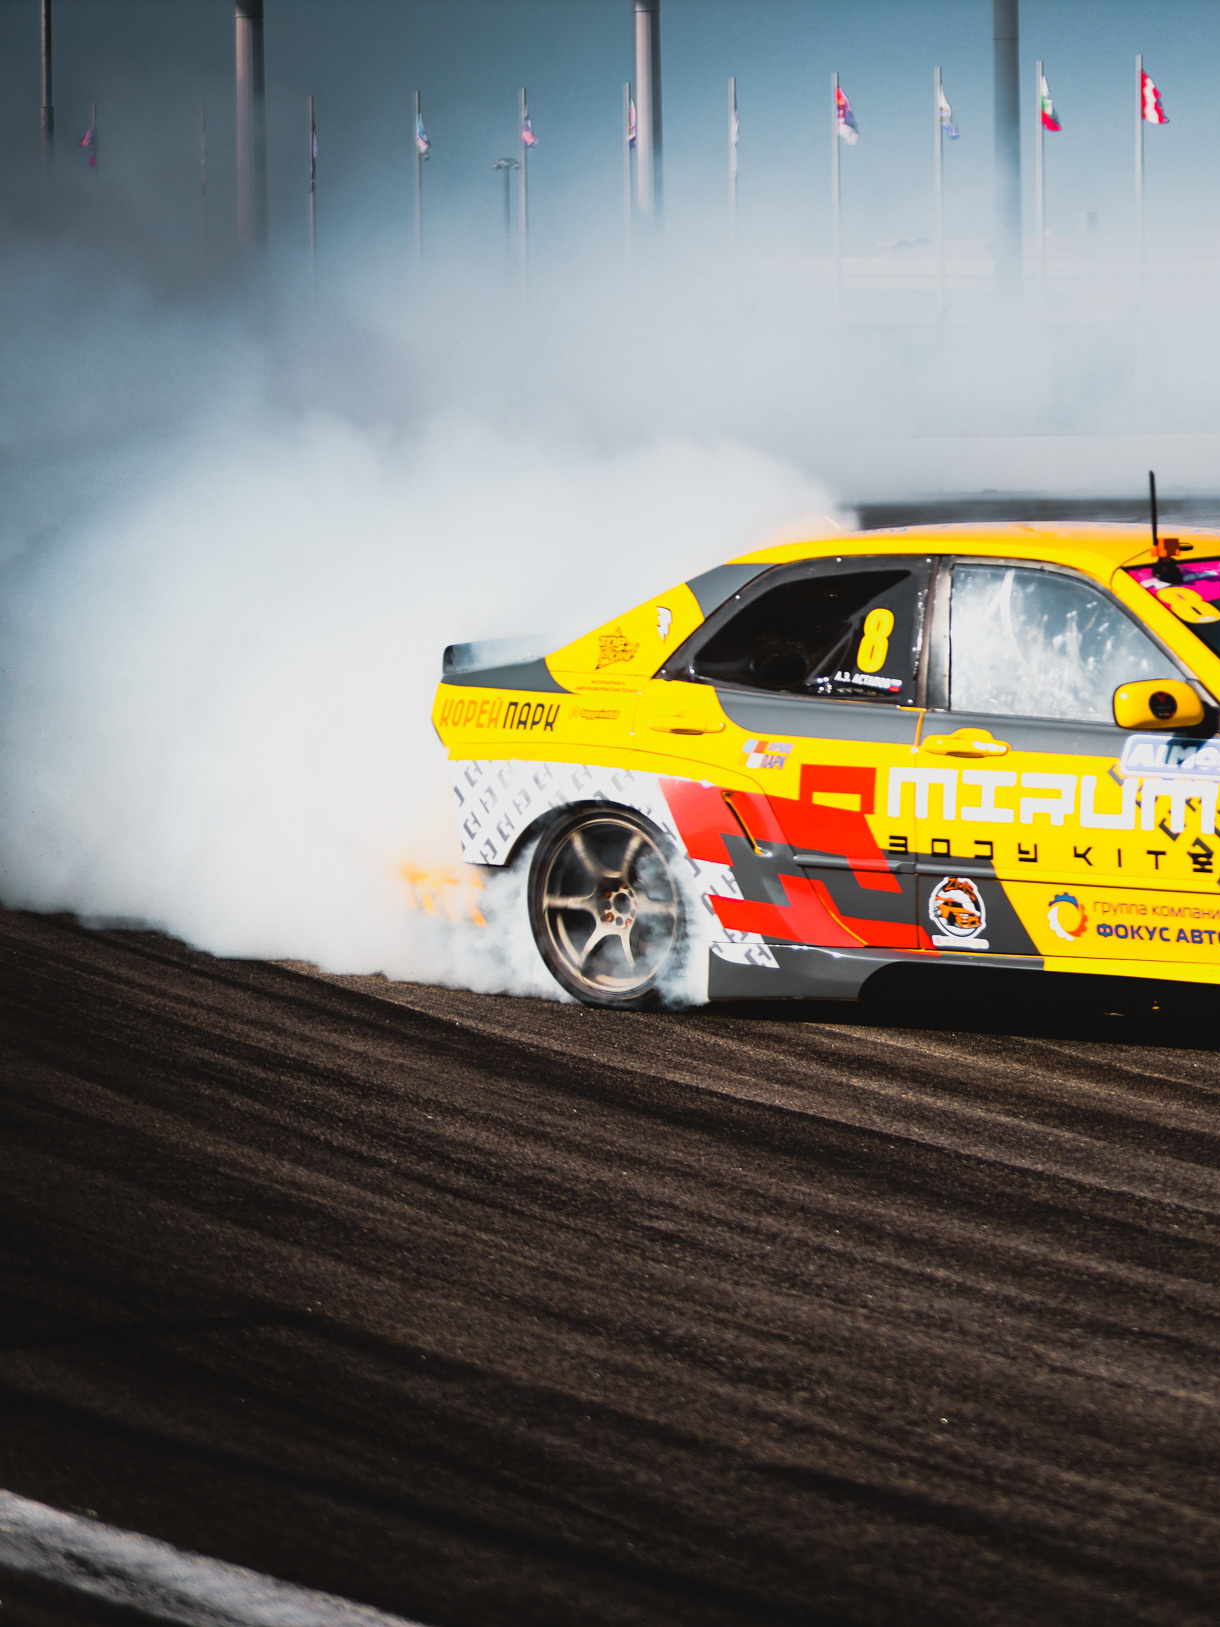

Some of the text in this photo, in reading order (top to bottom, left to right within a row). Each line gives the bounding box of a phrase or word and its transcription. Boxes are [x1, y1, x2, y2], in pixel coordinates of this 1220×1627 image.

[856, 607, 895, 673] 8
[886, 766, 1219, 835] MIRUM
[1096, 922, 1171, 943] ФОКУС
